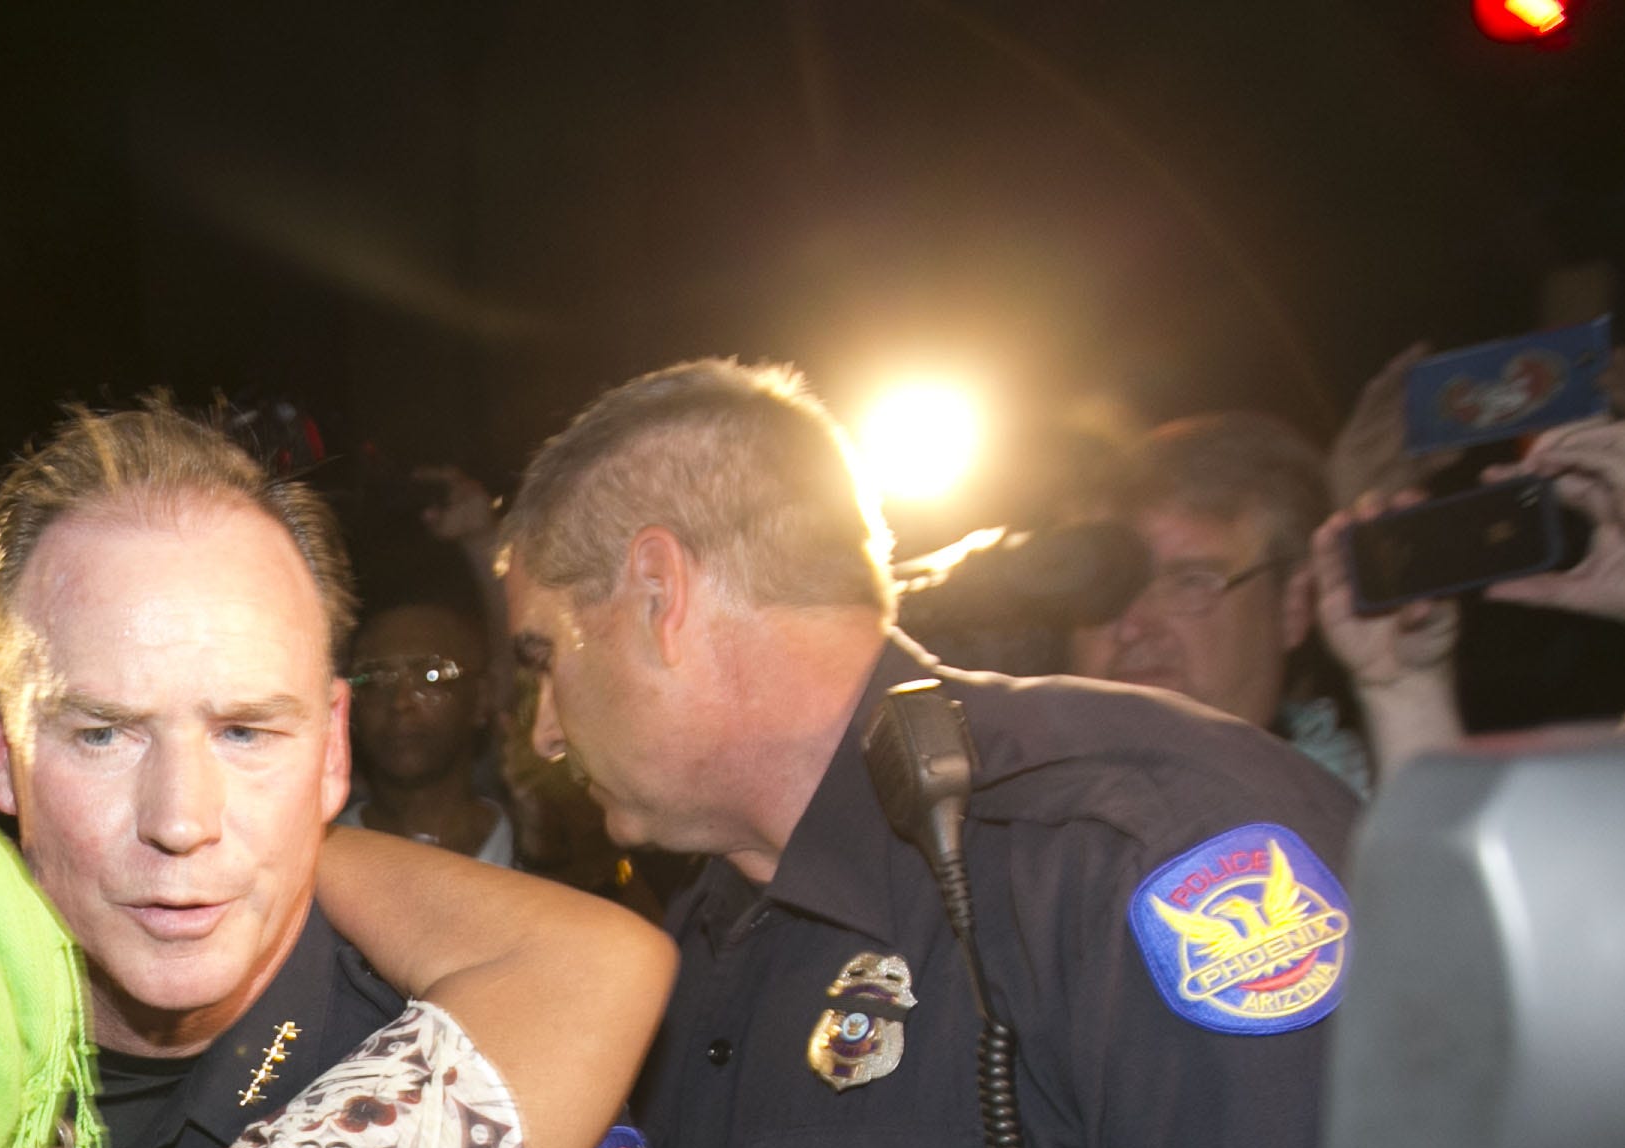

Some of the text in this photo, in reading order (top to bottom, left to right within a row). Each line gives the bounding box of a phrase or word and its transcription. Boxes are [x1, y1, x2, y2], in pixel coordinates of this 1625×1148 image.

[1170, 849, 1268, 908] POLICE
[1199, 918, 1338, 988] PHOENIX
[1241, 963, 1337, 1012] ARIZONA
